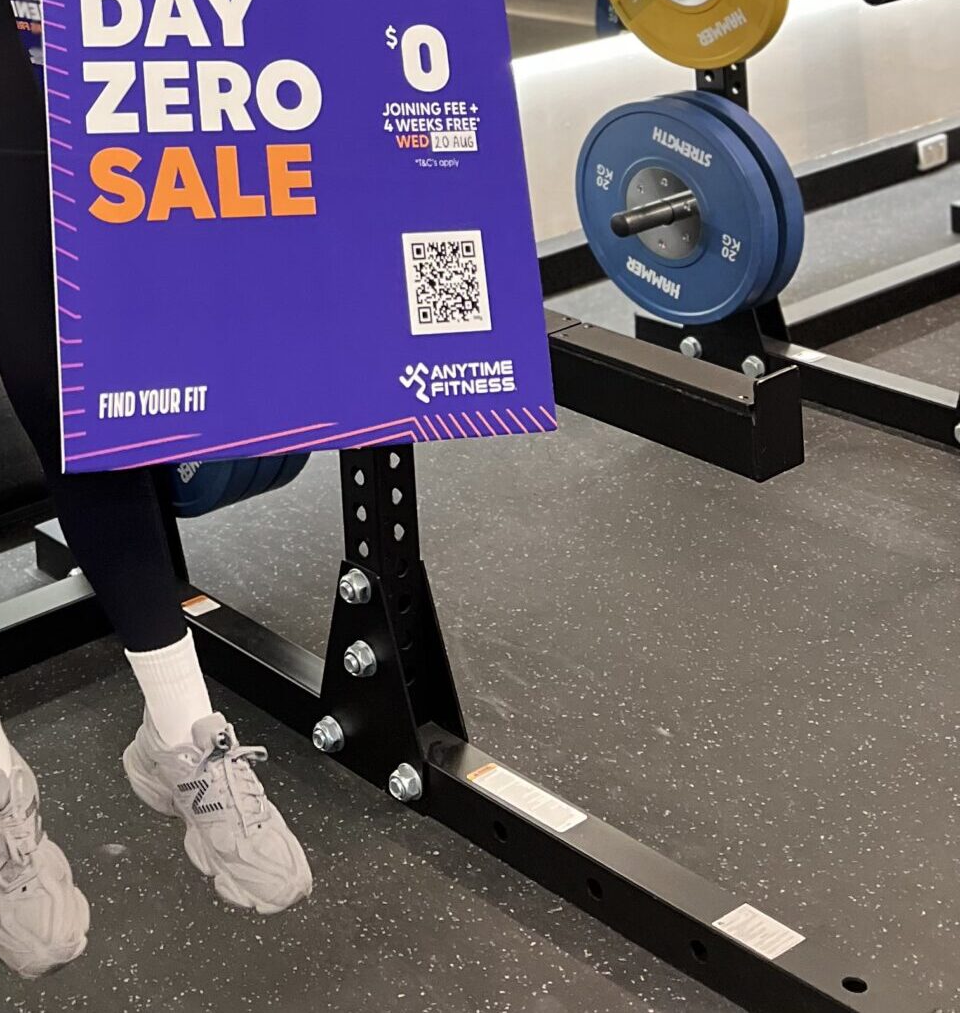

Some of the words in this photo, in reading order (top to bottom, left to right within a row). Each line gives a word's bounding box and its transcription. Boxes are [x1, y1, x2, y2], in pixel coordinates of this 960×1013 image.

[696, 9, 748, 47] HAMMER
[83, 59, 322, 134] ZERO
[382, 102, 441, 117] JOINING
[444, 102, 467, 116] FEE
[384, 119, 393, 132] 4
[395, 118, 443, 132] WEEKS
[396, 135, 429, 149] WED
[435, 136, 449, 149] 20
[453, 136, 474, 149] AUG
[652, 126, 712, 167] STRENGTH
[438, 158, 460, 168] apply
[596, 163, 614, 179] KG
[89, 144, 317, 224] SALE
[596, 176, 610, 190] 20
[722, 233, 741, 251] KG
[721, 248, 737, 262] 20
[626, 256, 681, 300] HAMMER
[430, 360, 514, 380] ANYTIME
[431, 377, 516, 397] FITNESS
[99, 391, 136, 419] FIND
[139, 388, 181, 416] YOUR
[184, 386, 208, 412] FIT
